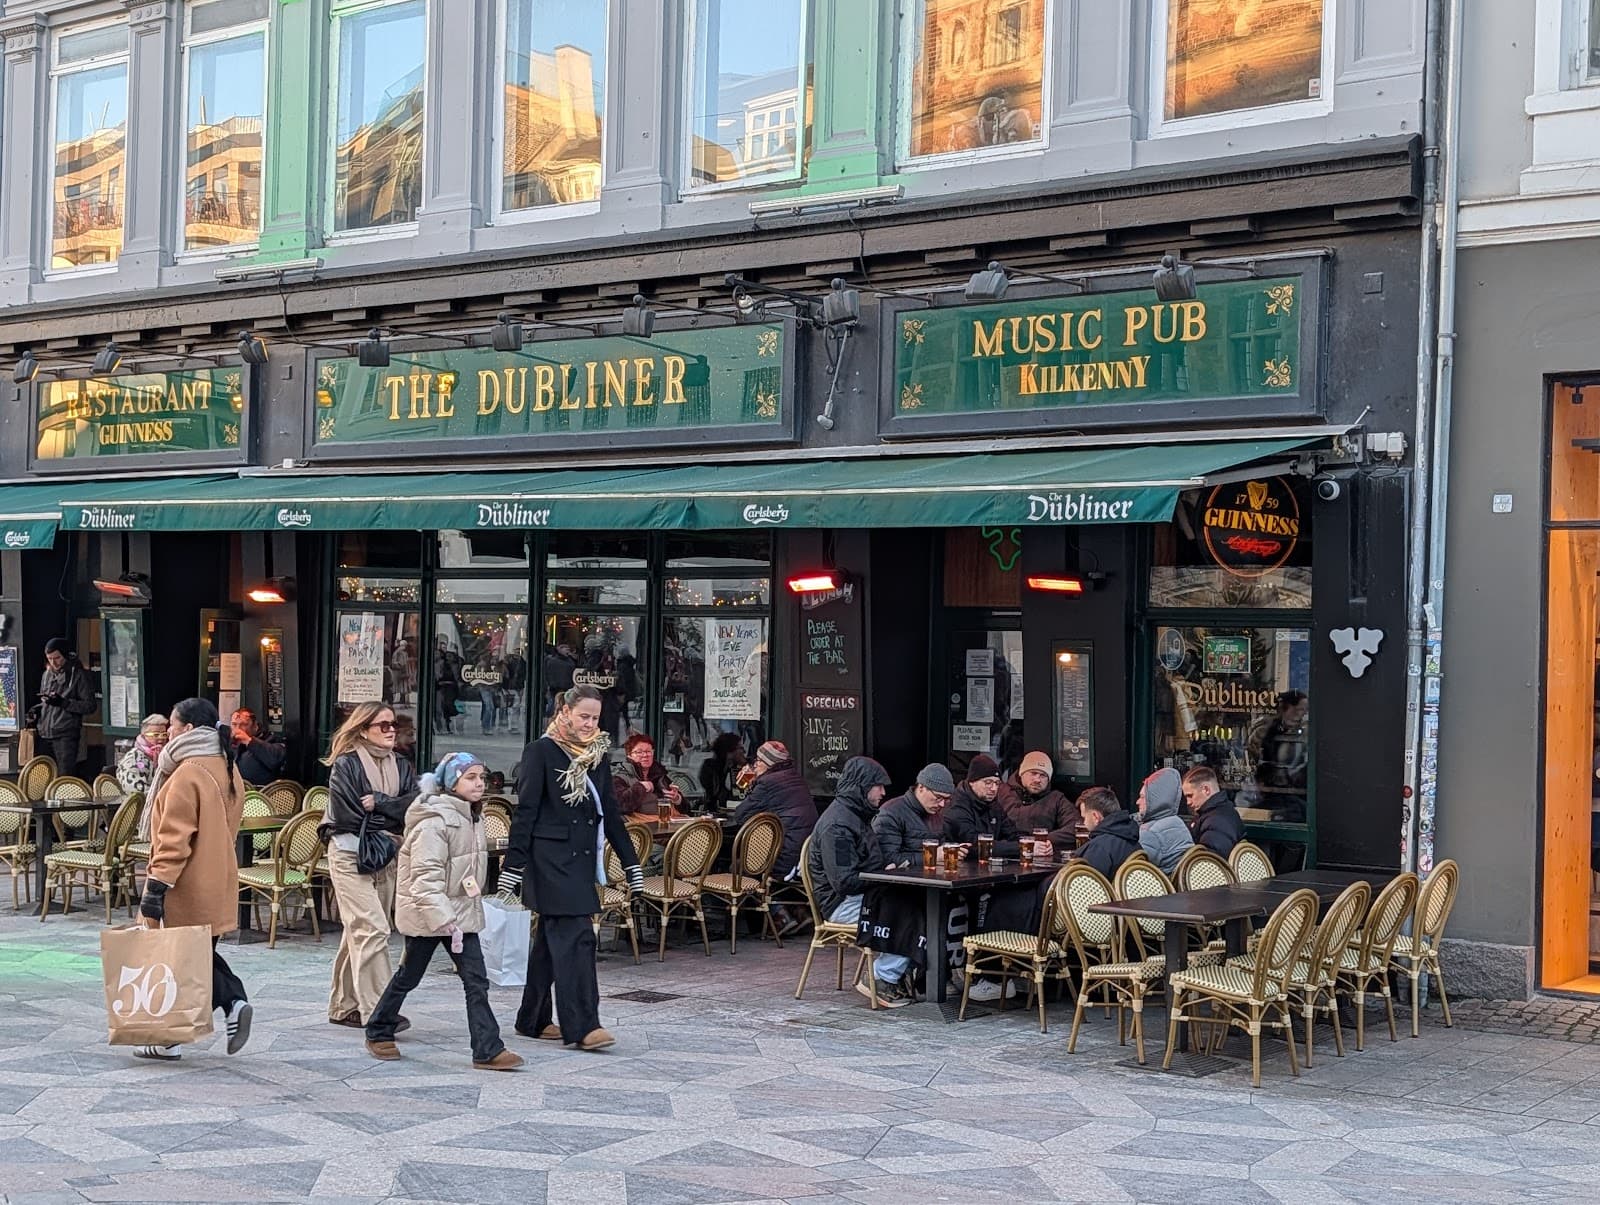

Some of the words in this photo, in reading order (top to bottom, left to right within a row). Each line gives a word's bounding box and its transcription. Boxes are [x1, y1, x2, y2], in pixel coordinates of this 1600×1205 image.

[972, 309, 1102, 357] MUSIC
[1123, 301, 1207, 346] PUB
[1018, 355, 1151, 396] KILKENNY
[386, 372, 455, 420] THE
[477, 355, 687, 415] DUBLINER
[65, 381, 212, 419] RESTAURANT
[99, 420, 173, 445] GUINNESS
[1235, 494, 1247, 505] 17
[1266, 497, 1279, 509] 59
[278, 509, 312, 527] Carlsberg
[743, 504, 789, 524] Carlsberg
[1204, 508, 1299, 537] GUINNESS
[715, 625, 733, 639] NEW
[723, 641, 742, 652] EVE
[718, 654, 749, 670] PARTY
[461, 664, 501, 687] Carlsberg
[572, 668, 616, 689] Carlsberg
[806, 695, 855, 709] SPECIALS
[808, 718, 833, 735] LIVE
[822, 736, 848, 751] MUSIC
